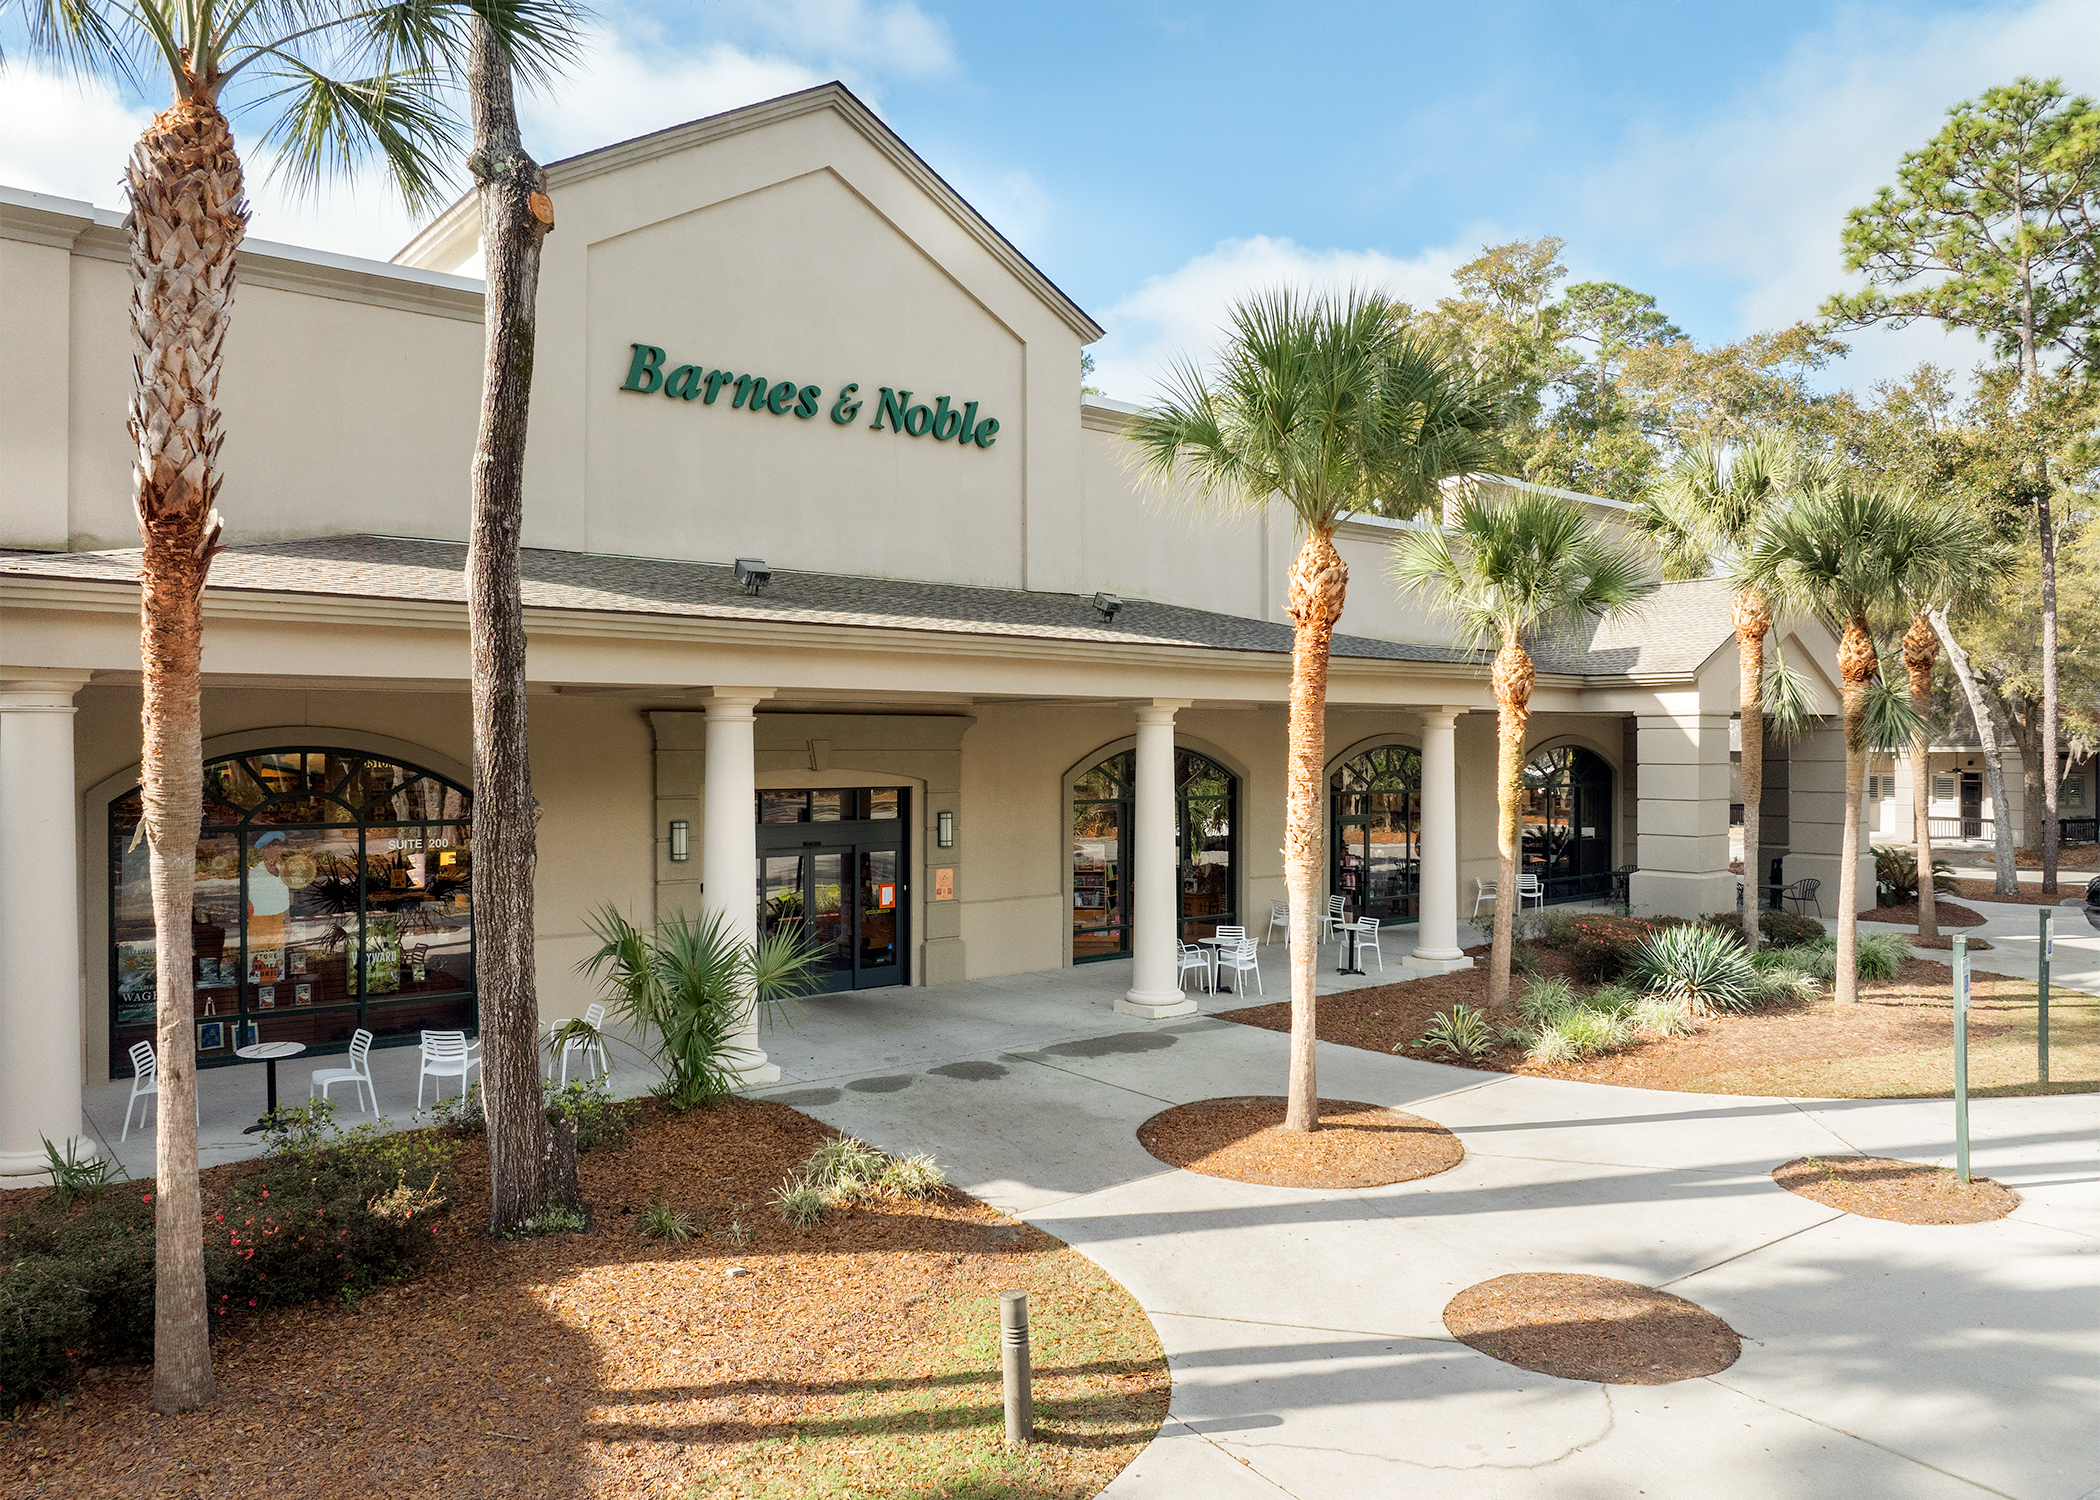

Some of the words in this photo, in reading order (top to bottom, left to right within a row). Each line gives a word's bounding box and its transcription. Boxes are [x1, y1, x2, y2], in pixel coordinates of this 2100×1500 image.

[619, 342, 822, 419] Barnes
[830, 383, 864, 425] &
[869, 386, 1001, 448] Noble
[388, 839, 423, 850] SUITE
[428, 838, 449, 849] 200
